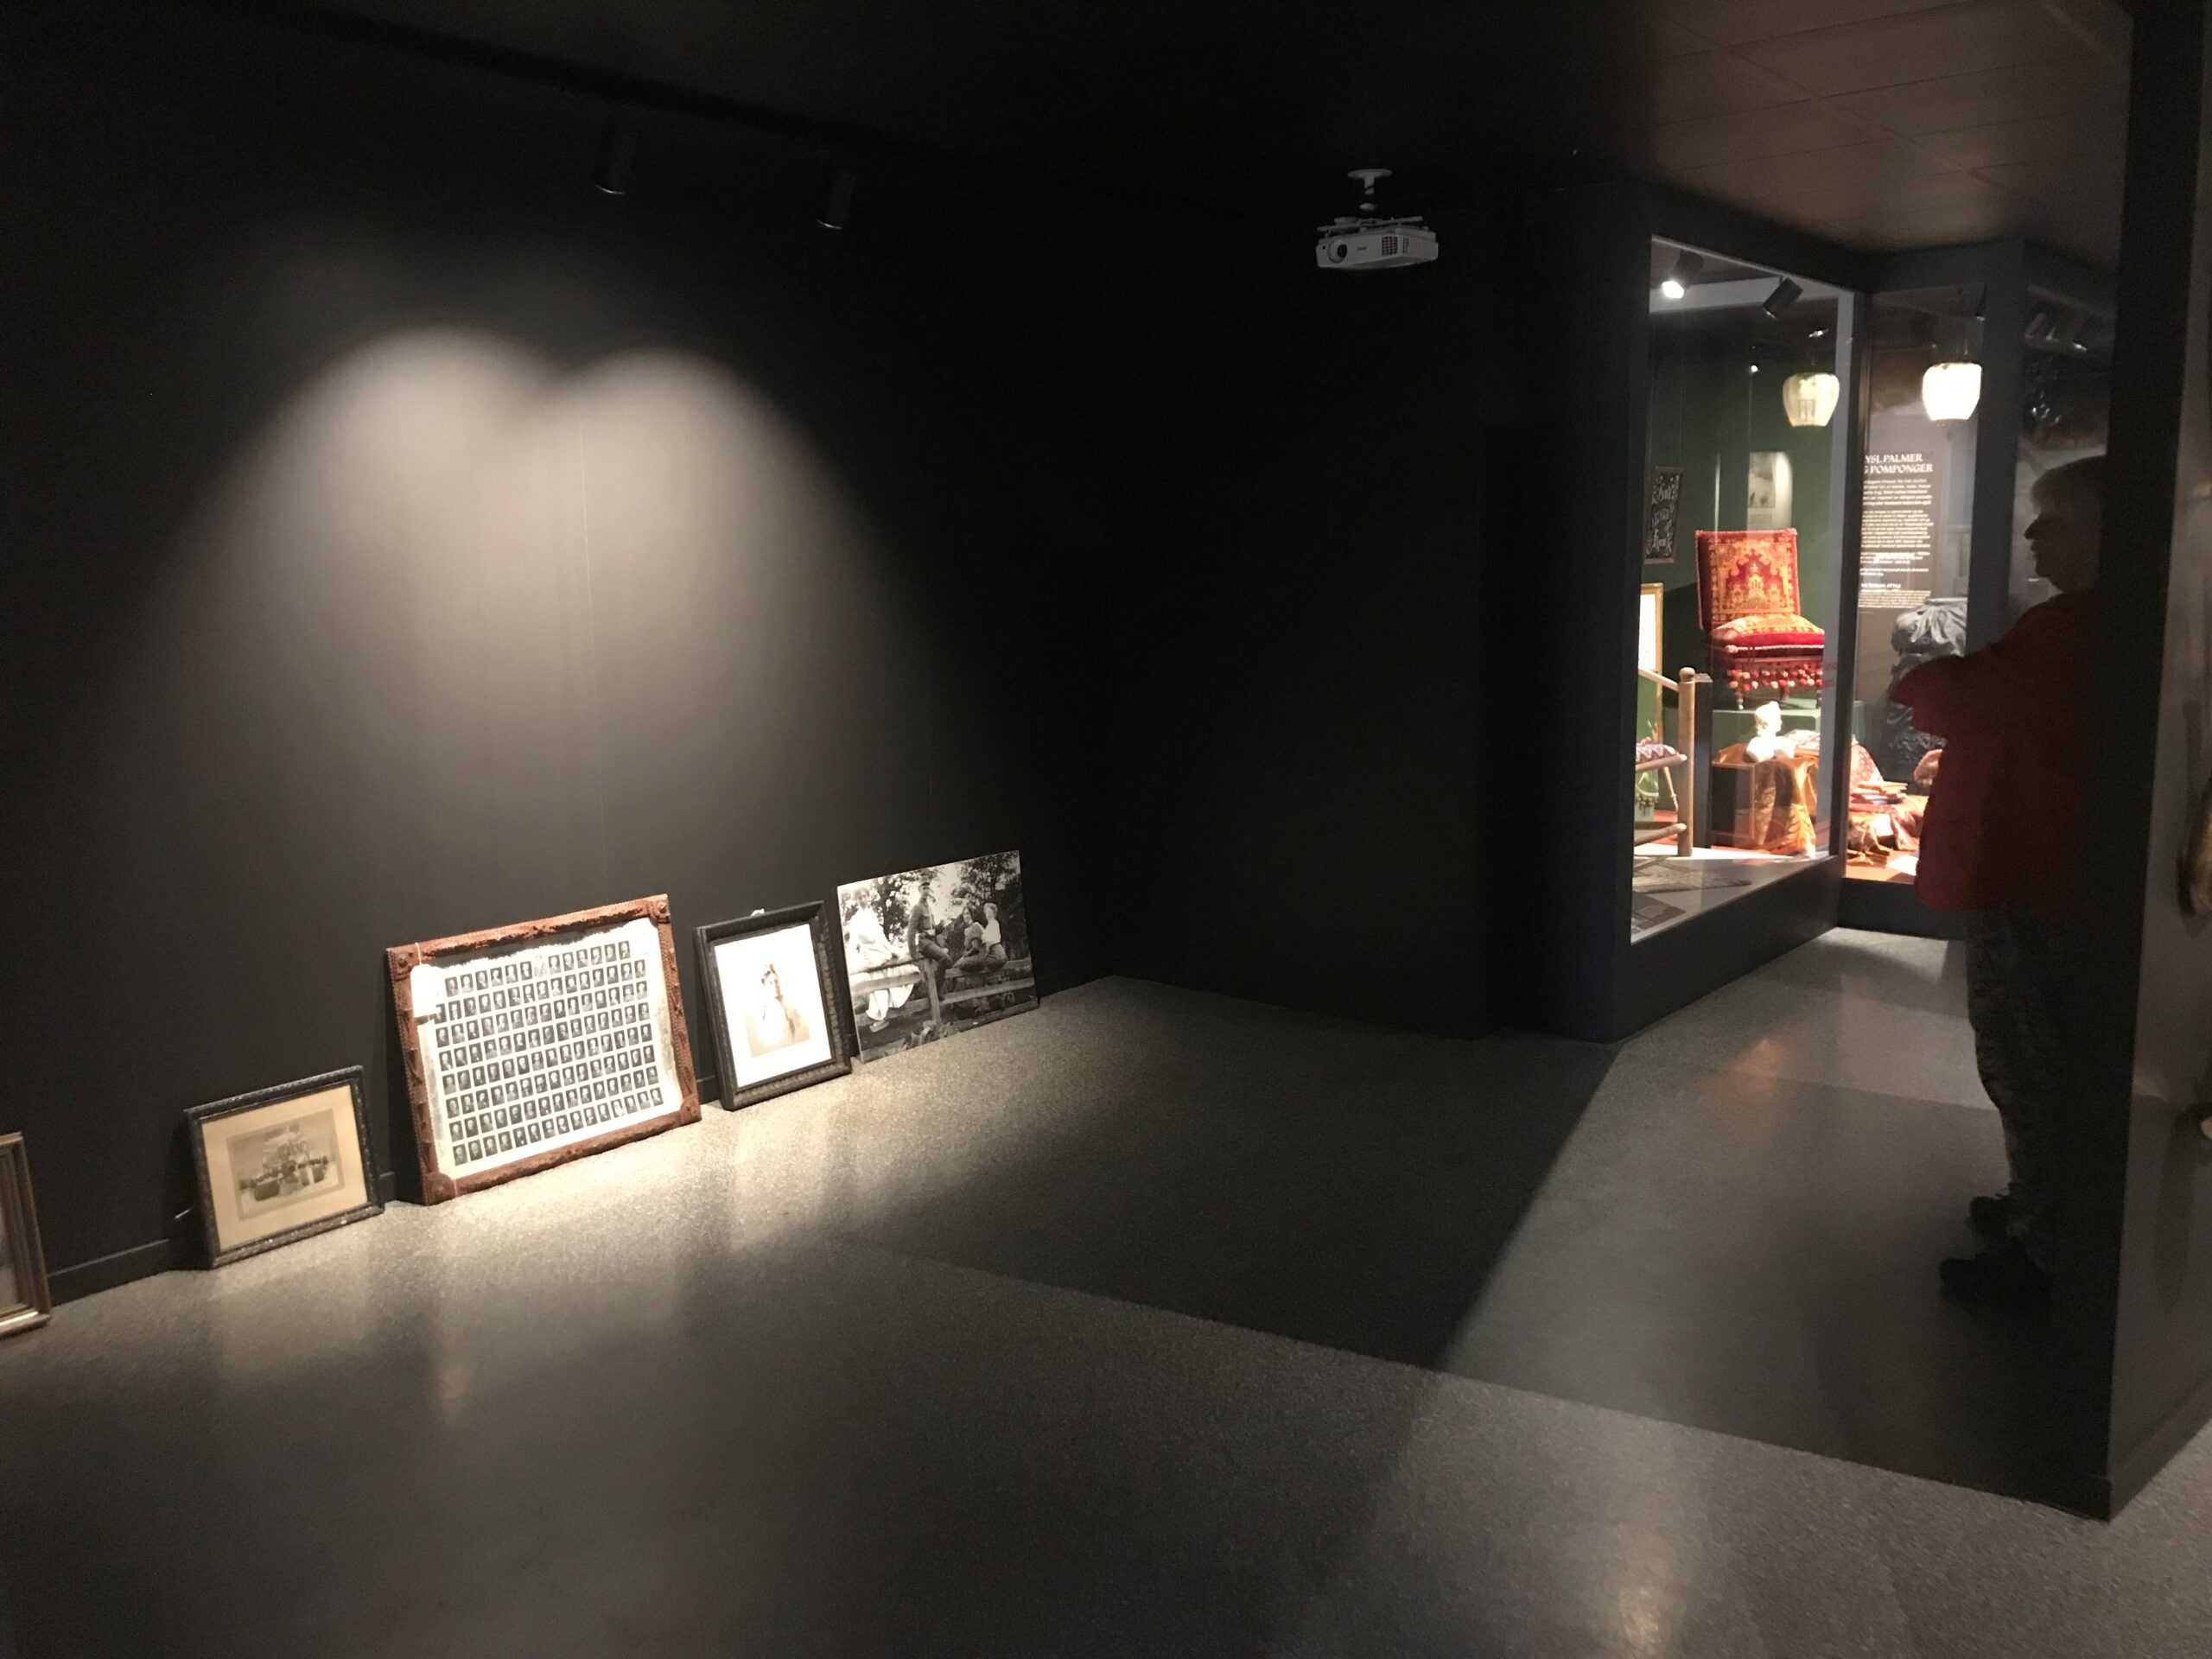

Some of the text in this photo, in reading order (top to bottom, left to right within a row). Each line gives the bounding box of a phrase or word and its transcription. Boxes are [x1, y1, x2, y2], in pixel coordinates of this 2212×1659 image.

[1865, 453, 1923, 464] YSJ, PALMER
[1870, 463, 1933, 474] POMPONGER
